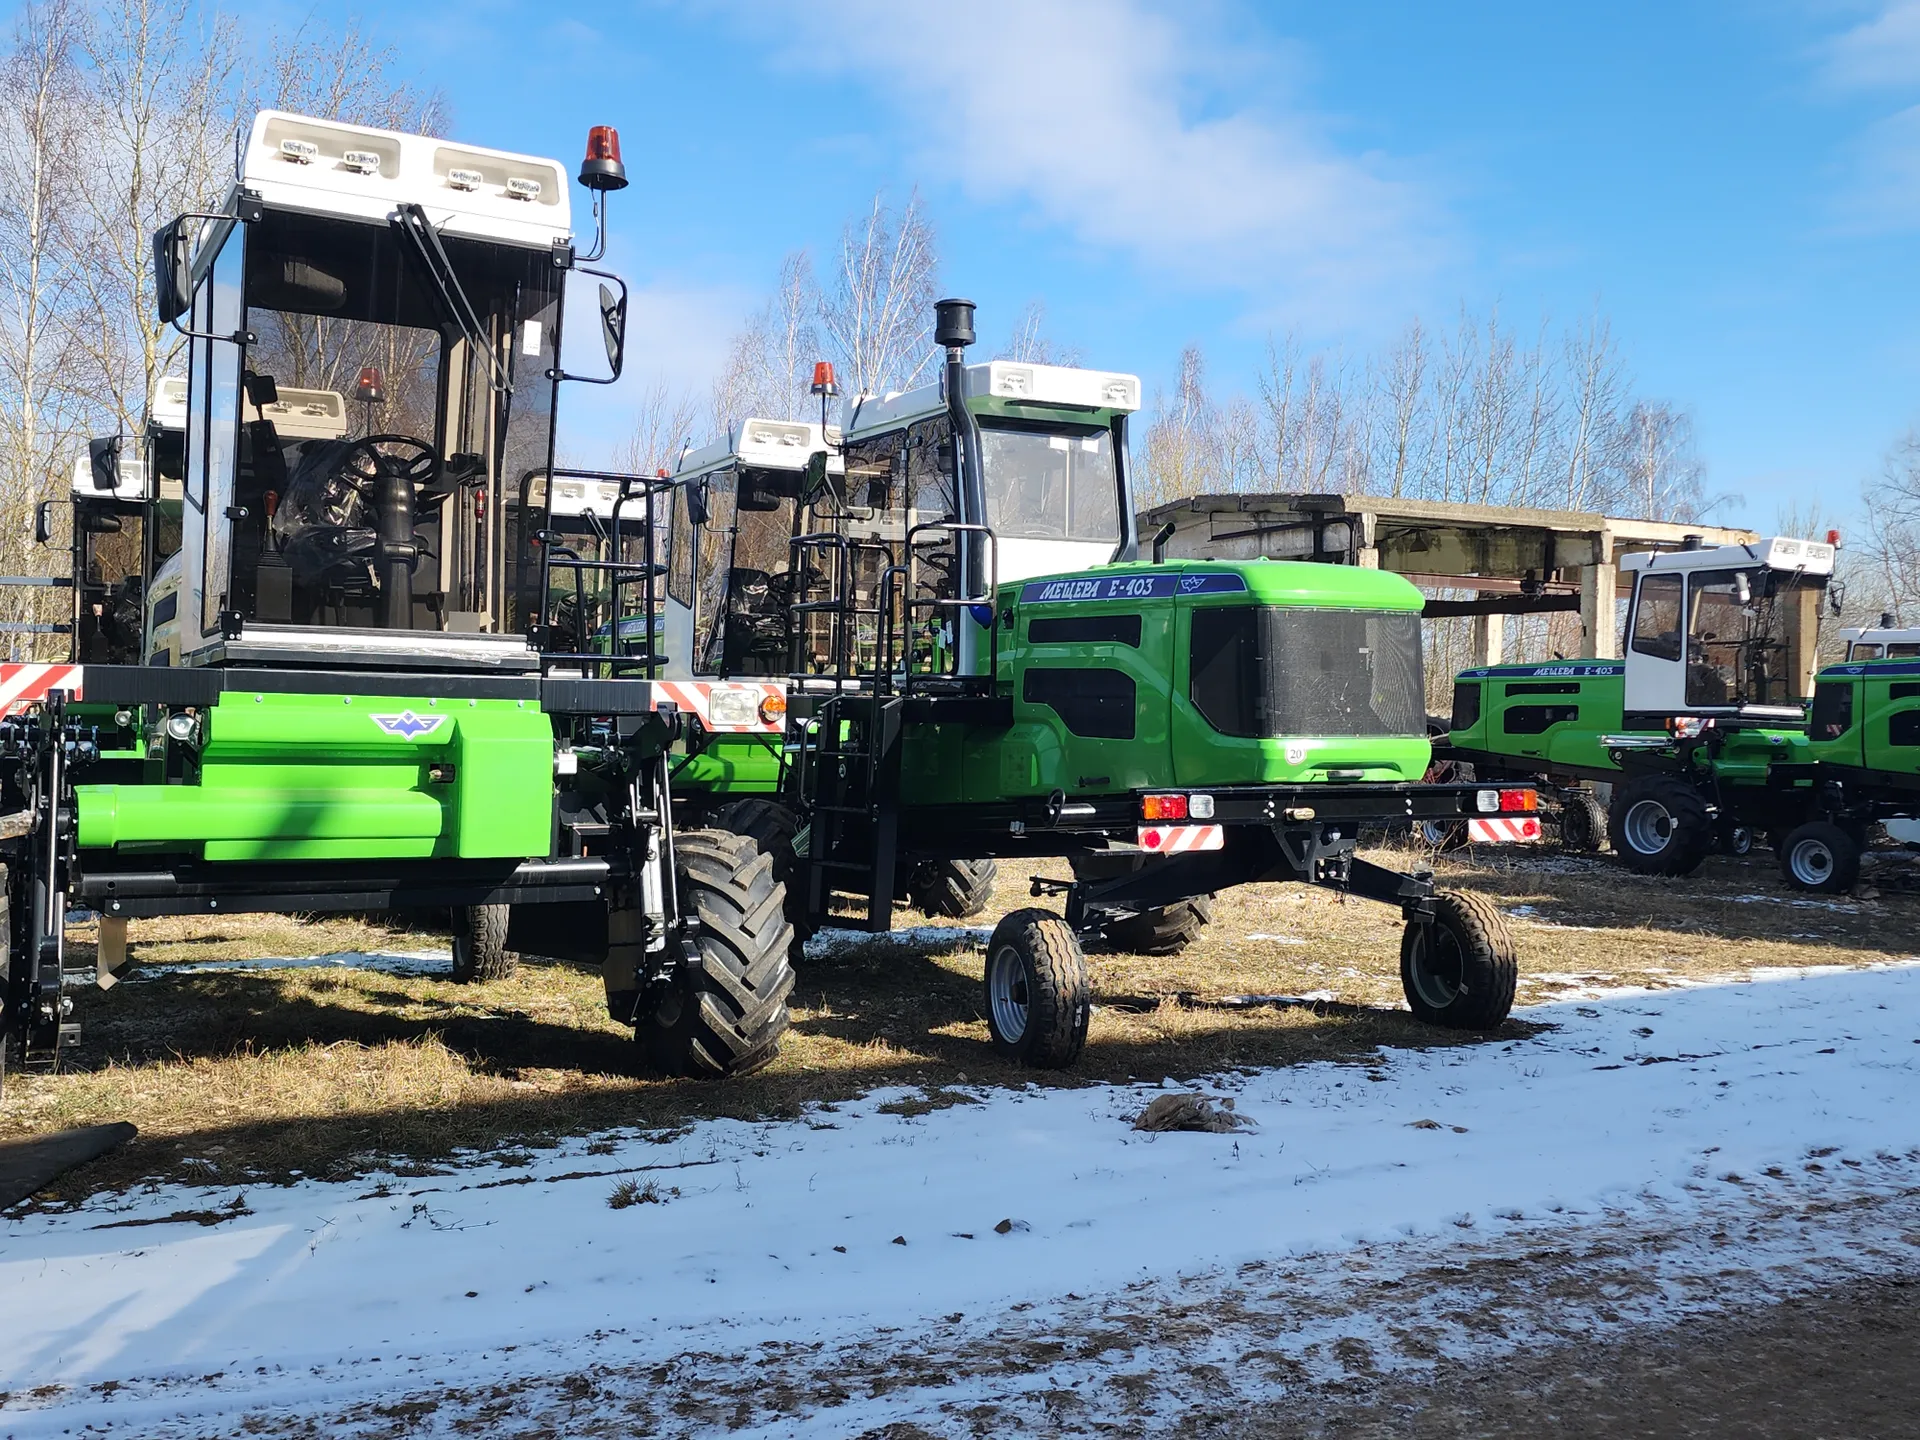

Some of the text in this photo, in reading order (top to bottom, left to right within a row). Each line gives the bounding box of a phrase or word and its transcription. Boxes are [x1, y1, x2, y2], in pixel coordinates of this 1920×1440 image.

[1039, 579, 1155, 600] МЕЩЕРА Е-403
[1533, 666, 1614, 676] МЕЩЕРА Е-403
[1290, 749, 1302, 759] 20
